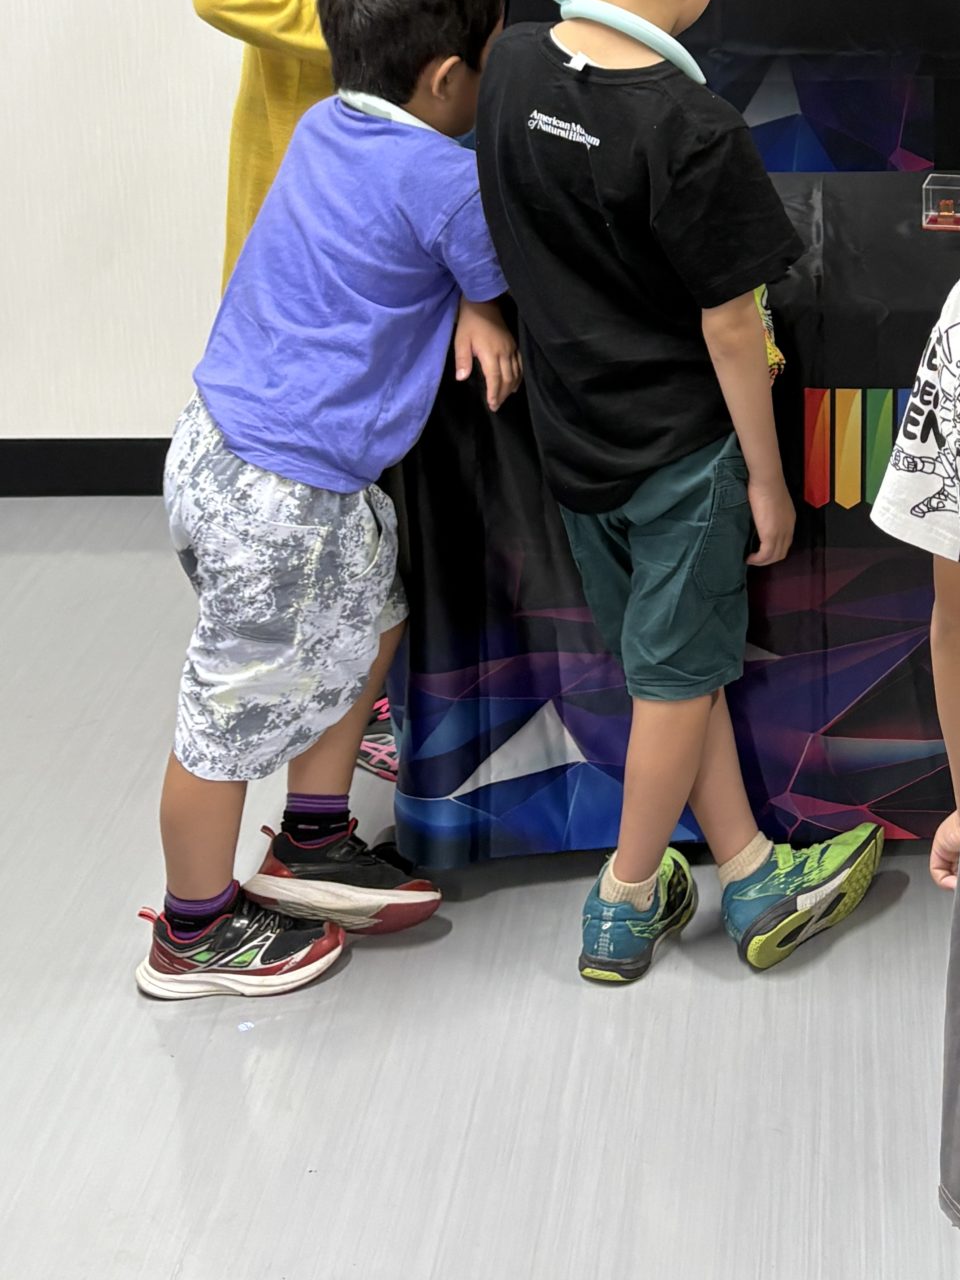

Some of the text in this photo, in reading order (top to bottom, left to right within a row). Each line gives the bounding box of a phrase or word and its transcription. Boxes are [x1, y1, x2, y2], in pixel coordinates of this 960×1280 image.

[527, 119, 538, 130] of
[536, 121, 570, 140] Natural
[529, 109, 600, 147] American Muum
